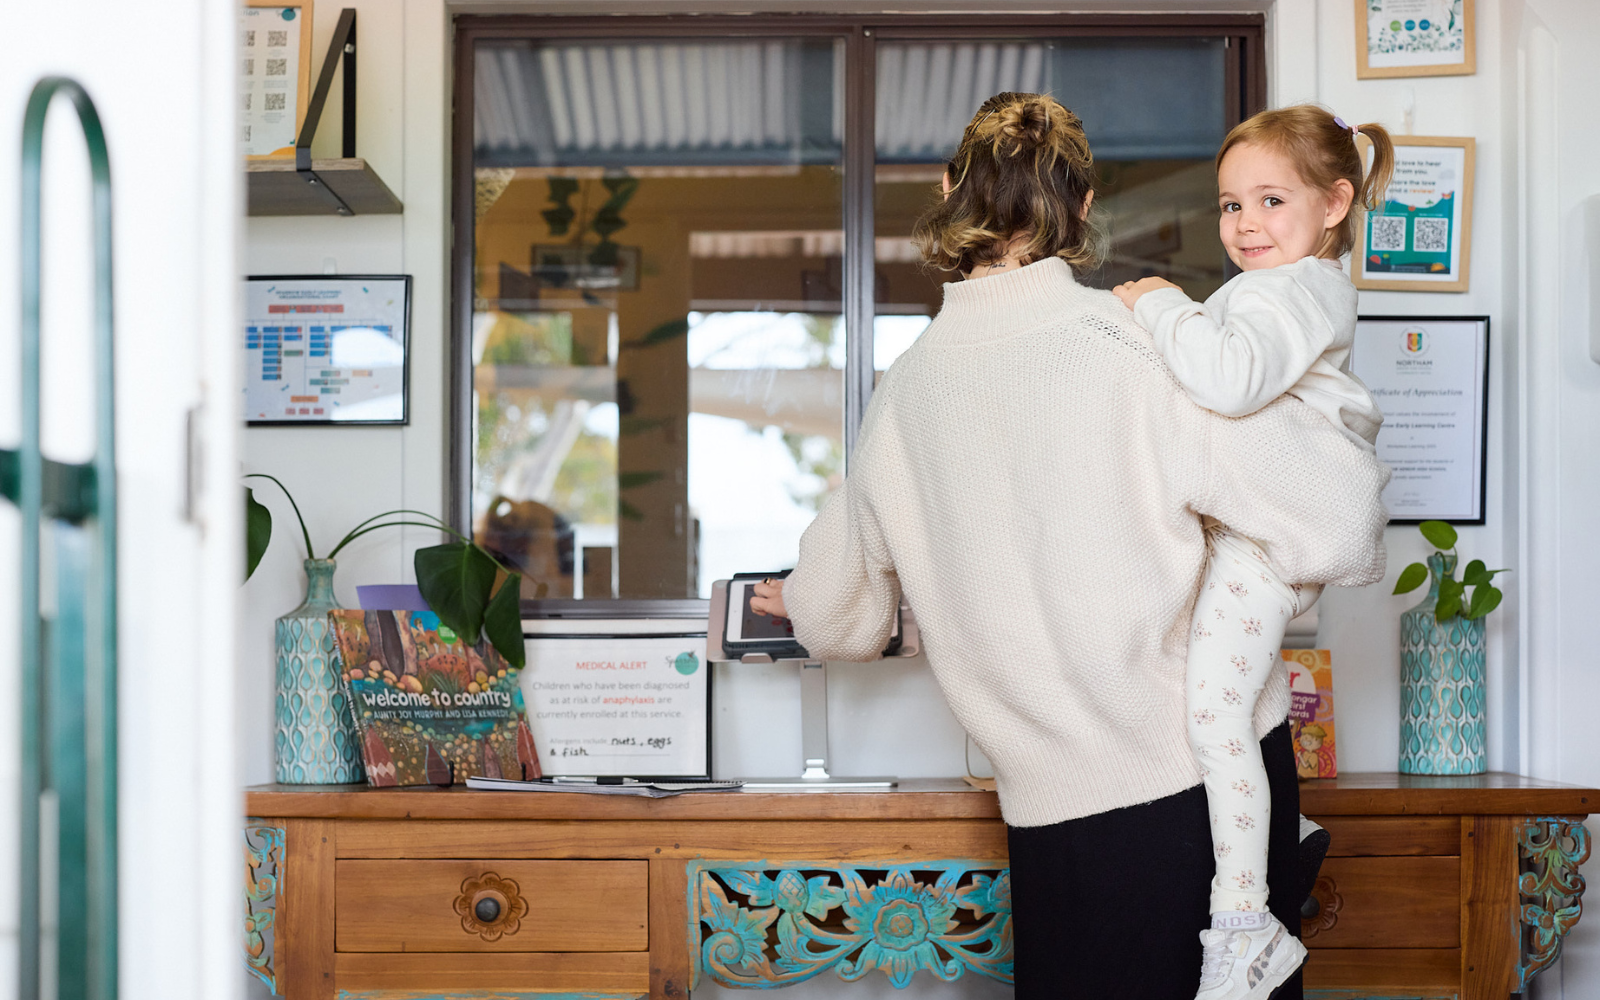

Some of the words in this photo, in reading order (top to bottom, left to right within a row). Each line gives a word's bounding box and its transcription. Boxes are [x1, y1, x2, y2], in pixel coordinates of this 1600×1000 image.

[1412, 387, 1462, 398] Appreciation
[576, 662, 616, 670] MEDICAL
[620, 662, 648, 670] ALERT
[532, 682, 570, 690] Children
[573, 682, 592, 690] who
[594, 682, 616, 690] have
[618, 682, 640, 690] been
[643, 681, 690, 693] diagnosed
[362, 688, 431, 707] welcome
[431, 688, 451, 706] to
[454, 688, 511, 708] country
[562, 696, 570, 704] at
[573, 696, 590, 704] risk
[591, 695, 602, 704] of
[602, 696, 655, 706] anaphylaxis
[374, 710, 397, 719] AUNTY
[399, 710, 412, 718] JOY
[414, 710, 442, 718] MURPHY
[446, 710, 460, 718] AND
[462, 710, 477, 718] LISA
[478, 710, 509, 718] KENNEDY
[536, 710, 578, 720] currently
[580, 710, 616, 718] enrolled
[620, 710, 628, 718] at
[631, 710, 648, 718] this
[550, 738, 581, 746] Allergens
[647, 737, 672, 748] eggs
[562, 747, 590, 757] fish
